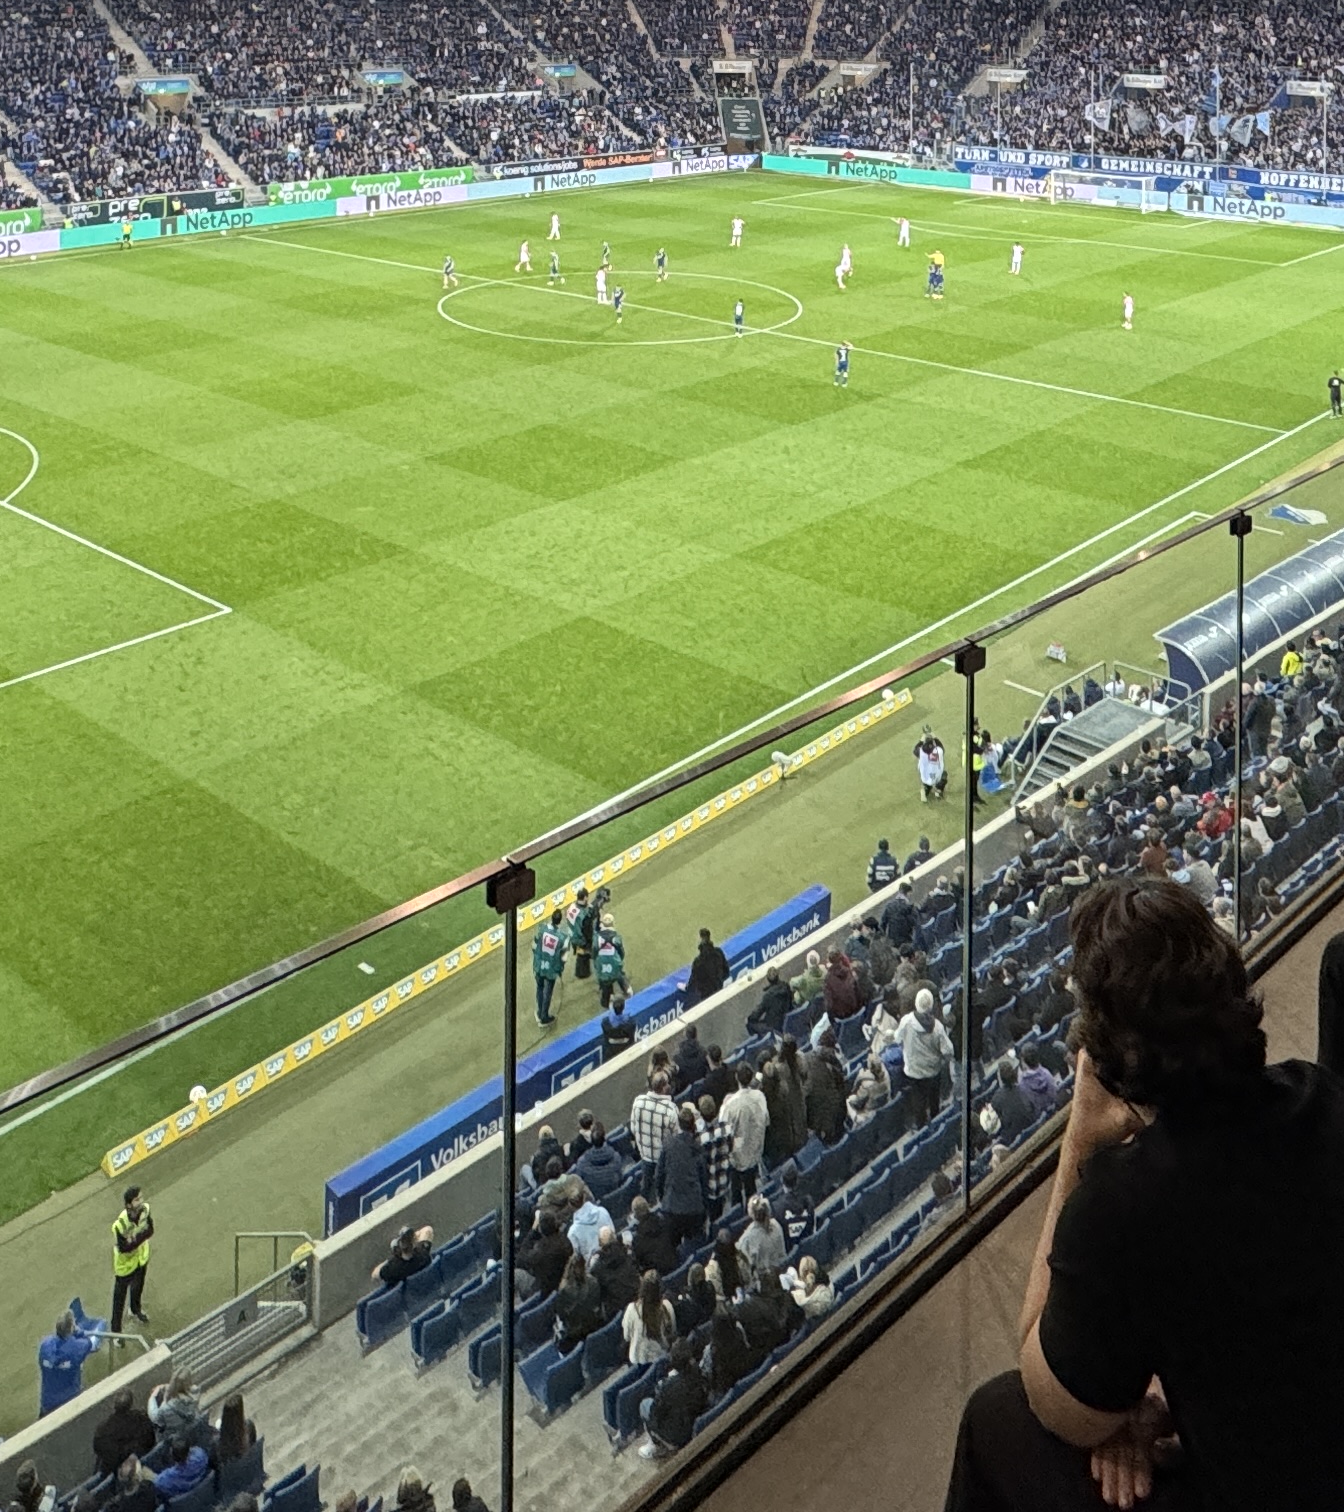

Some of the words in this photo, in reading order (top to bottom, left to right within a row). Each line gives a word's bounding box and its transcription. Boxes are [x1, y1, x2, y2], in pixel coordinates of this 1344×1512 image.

[686, 156, 725, 172] NetApp
[845, 162, 898, 181] NetApp
[956, 148, 996, 161] TURN-
[999, 151, 1026, 164] UND
[1029, 153, 1070, 168] SPORT
[1101, 159, 1214, 180] GEMEINSCHAFT
[551, 173, 597, 189] NetApp
[108, 198, 140, 216] pre
[387, 189, 443, 209] NetApp
[1213, 197, 1286, 219] NetApp
[186, 210, 253, 231] NetApp
[430, 1116, 504, 1172] Volksba
[634, 999, 685, 1043] ksbank
[761, 912, 822, 962] Volksbank
[112, 1146, 133, 1168] SAP
[145, 1129, 166, 1150] SAP
[176, 1110, 196, 1131] SAP
[207, 1093, 226, 1112] SAP
[236, 1075, 254, 1095] SAP
[266, 1058, 285, 1077] SAP
[294, 1042, 312, 1060] SAP
[321, 1027, 338, 1045] SAP
[347, 1011, 364, 1030] SAP
[372, 996, 389, 1014] SAP
[397, 981, 414, 999] SAP
[421, 967, 437, 985] SAP
[445, 954, 460, 971] SAP
[466, 940, 482, 958] SAP
